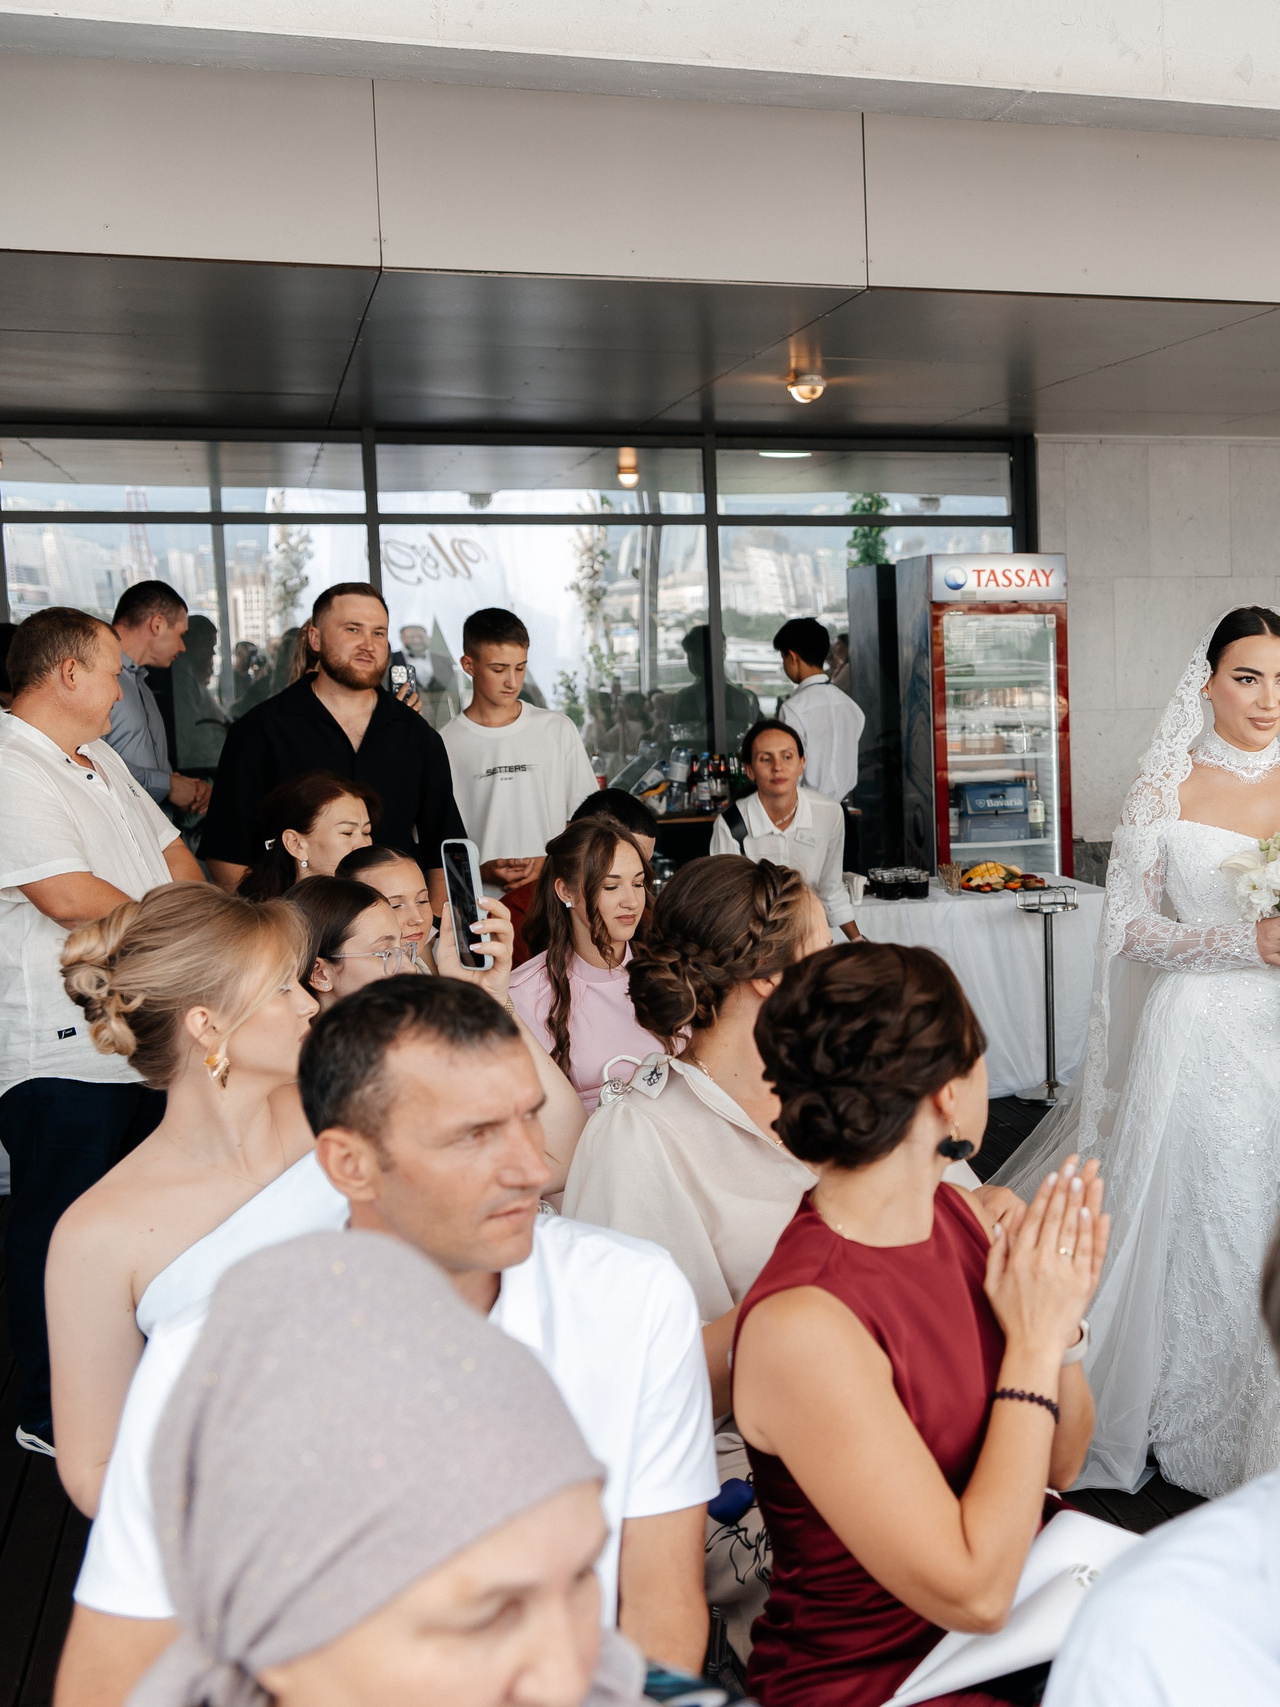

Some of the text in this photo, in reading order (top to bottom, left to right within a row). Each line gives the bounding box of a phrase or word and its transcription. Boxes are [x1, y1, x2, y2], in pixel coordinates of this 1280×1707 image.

[972, 568, 1055, 588] TASSAY
[485, 764, 527, 776] SETTERS
[986, 798, 1024, 808] Bavaria
